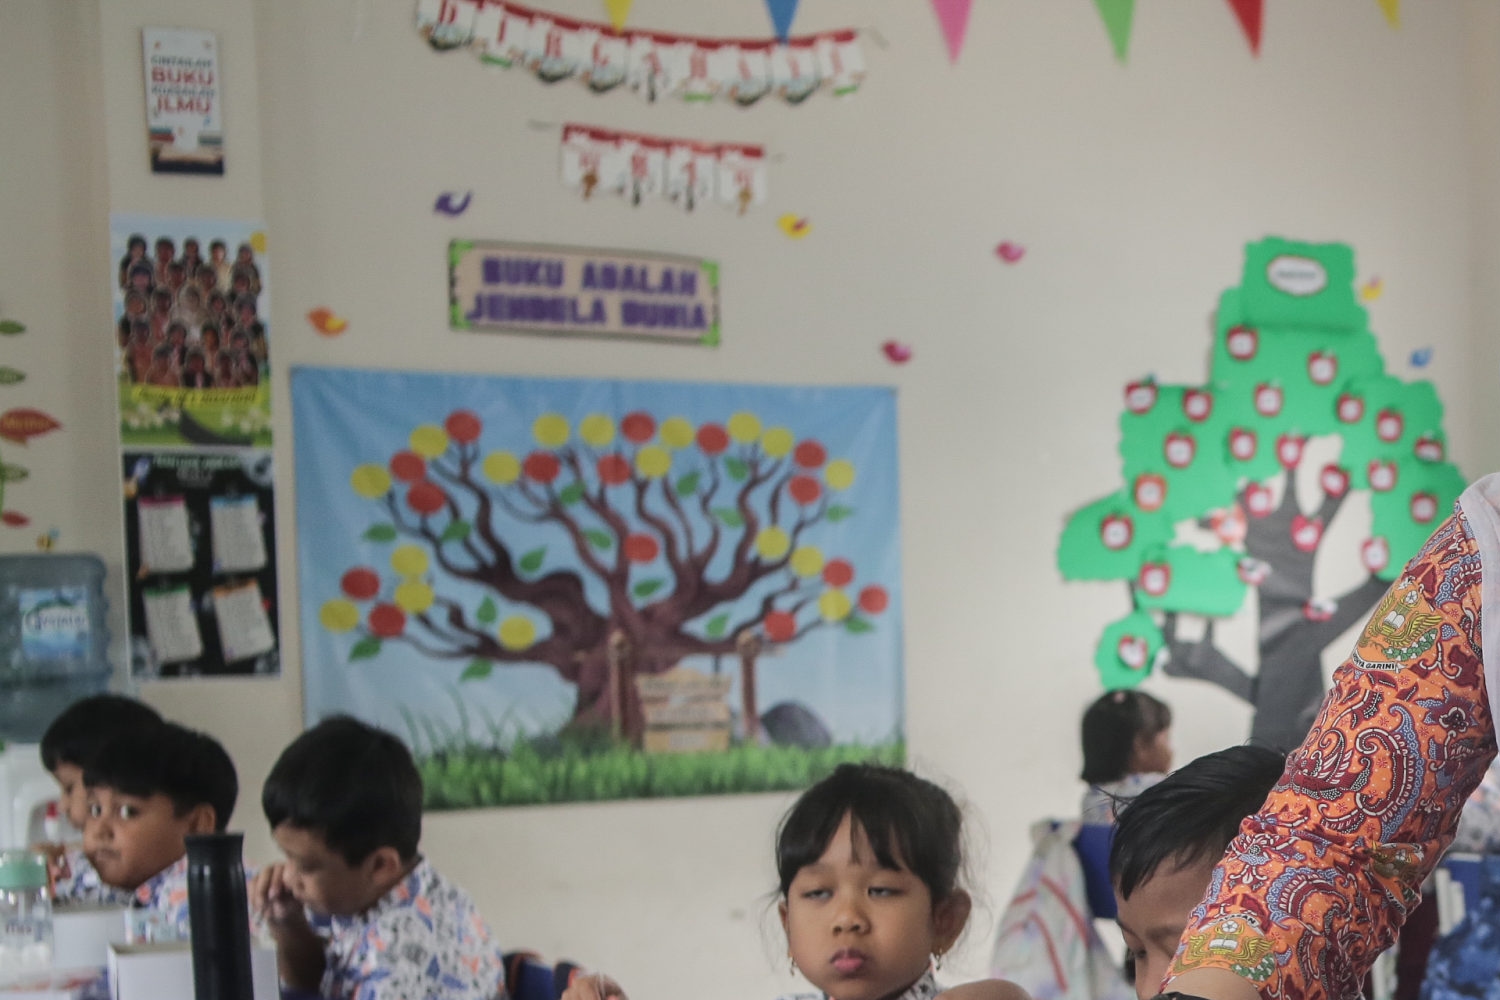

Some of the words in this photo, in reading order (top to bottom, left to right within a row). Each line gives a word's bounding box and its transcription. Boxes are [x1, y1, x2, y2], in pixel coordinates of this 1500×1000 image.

[151, 66, 214, 86] BUKU
[157, 97, 211, 114] ILMU
[482, 256, 563, 288] BUKU
[582, 262, 697, 297] ADALAH
